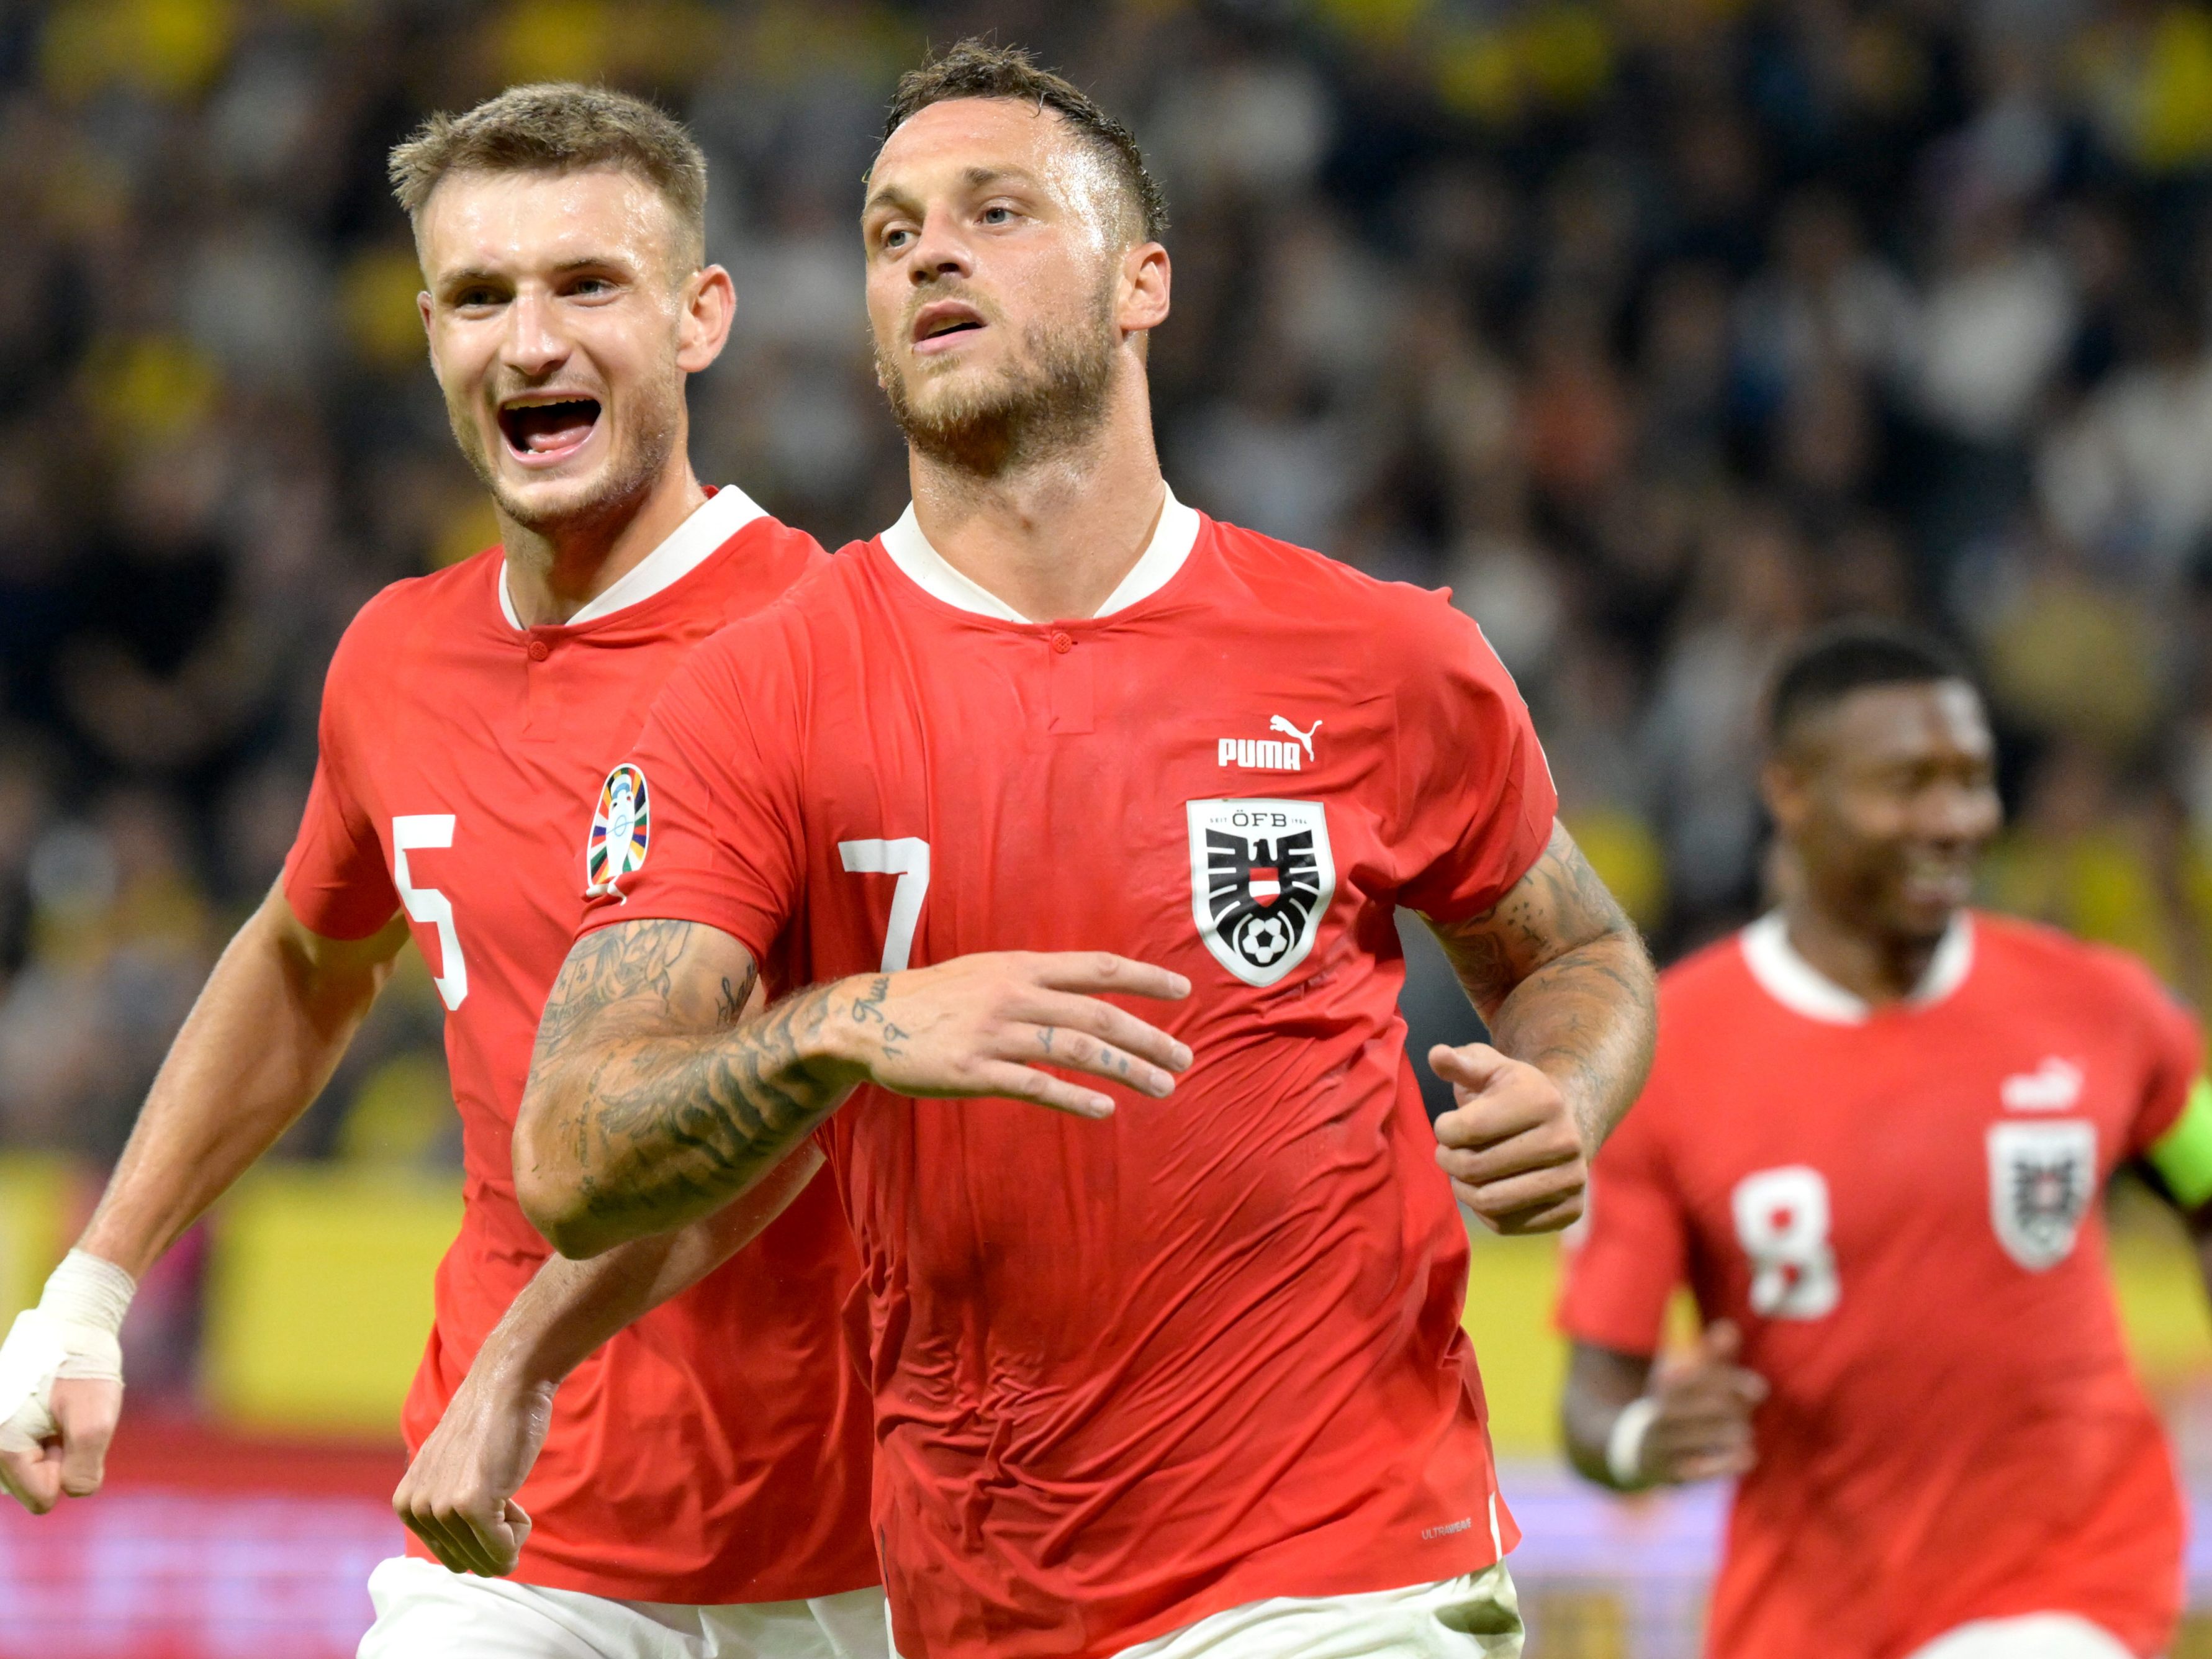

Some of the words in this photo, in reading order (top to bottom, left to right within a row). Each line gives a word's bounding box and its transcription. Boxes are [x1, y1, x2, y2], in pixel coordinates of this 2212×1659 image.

[1218, 738, 1301, 771] PUMA
[1232, 810, 1287, 827] ÖFB
[392, 814, 467, 1011] 5
[837, 836, 930, 974] 7
[1732, 1163, 1841, 1321] 8
[1422, 1517, 1471, 1540] ULTRAWEAVE
